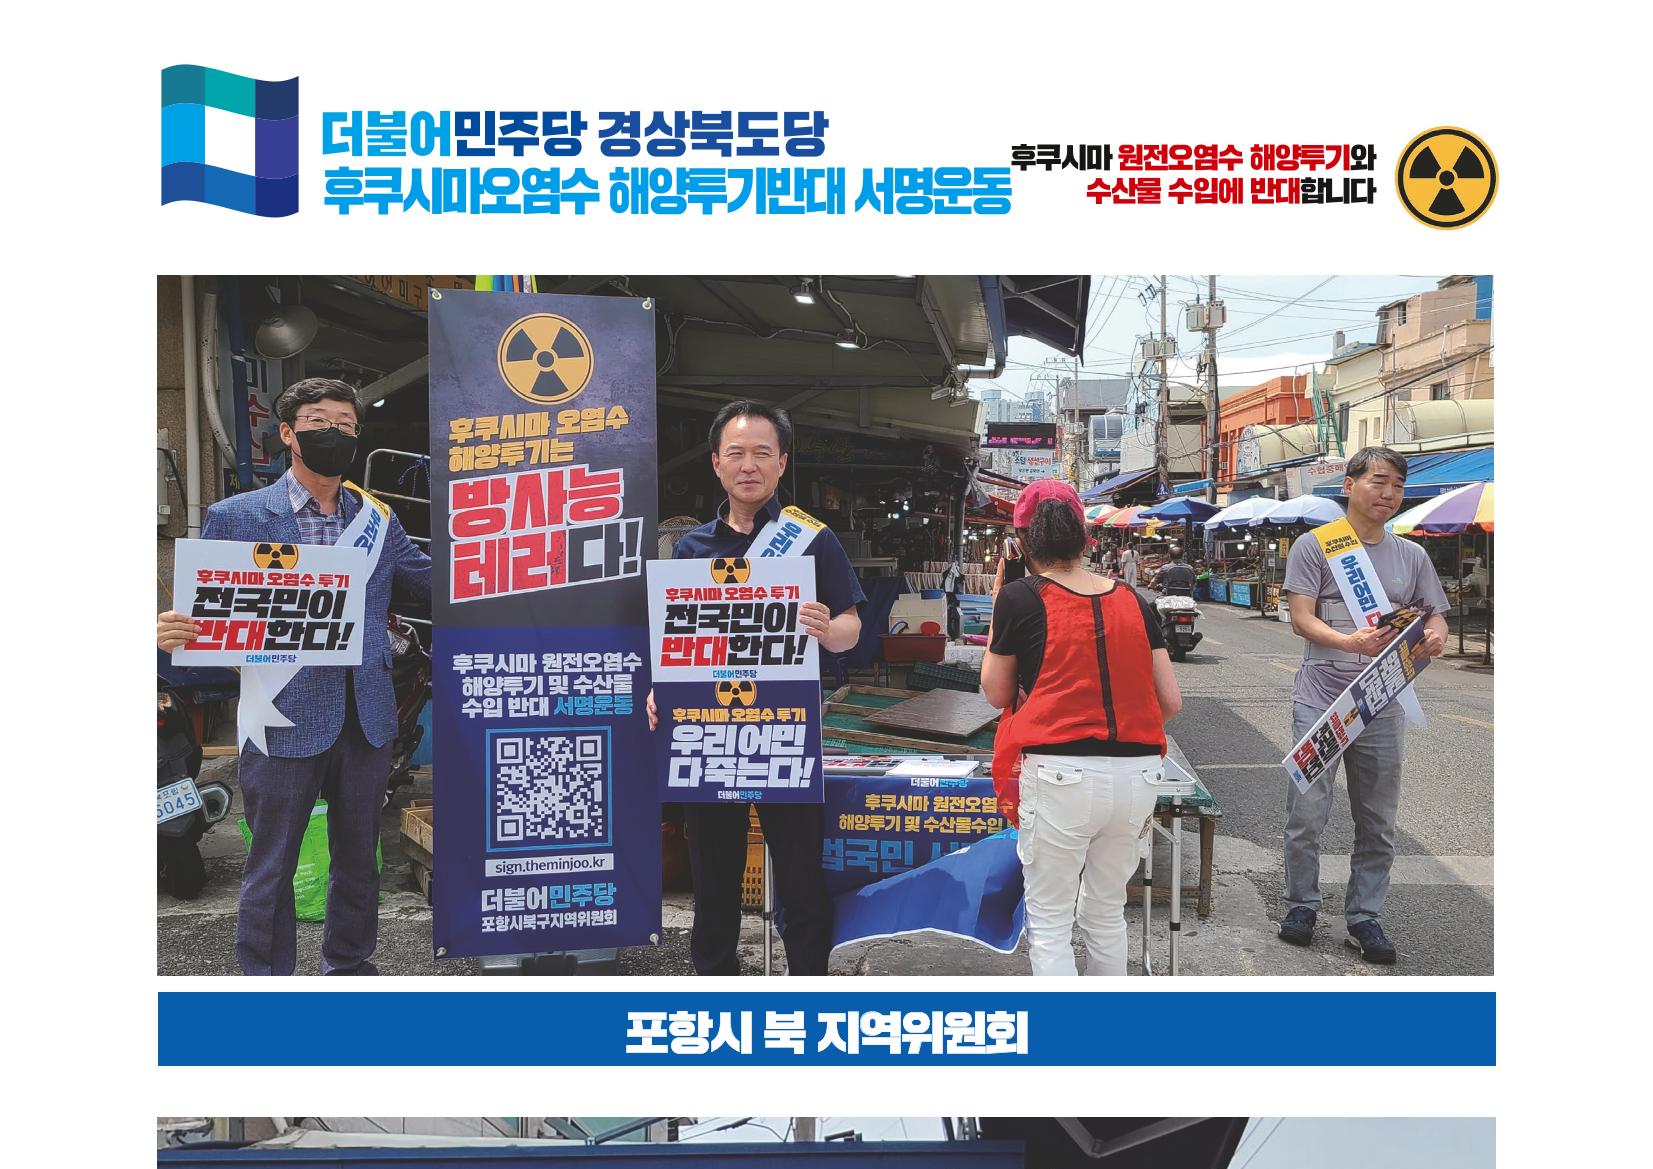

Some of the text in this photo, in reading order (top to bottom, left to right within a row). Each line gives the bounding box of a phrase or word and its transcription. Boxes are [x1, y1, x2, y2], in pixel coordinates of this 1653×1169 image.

[449, 405, 629, 444] 후쿠시마 오염수
[449, 438, 575, 472] 해양투기는
[449, 464, 624, 541] 방사능
[450, 517, 643, 604] 테러다!
[196, 569, 350, 588] 후쿠시마 오염수 투기
[191, 586, 347, 620] 전국민이
[665, 585, 800, 602] 후쿠시마 오염수 투기
[663, 602, 799, 634] 전국민이
[184, 619, 355, 651] 반대한다!
[660, 634, 808, 667] 반대한다!
[452, 652, 642, 674] 후쿠시마 원전오염수
[712, 669, 758, 679] 더불어민주당
[462, 674, 633, 697] 해양투기 및 수산물
[461, 695, 633, 718] 수입 반대 서명운동
[672, 708, 806, 723] 후쿠시마 오염수 투기
[865, 794, 929, 812] 후쿠시마
[838, 814, 900, 832] 해양투기
[904, 815, 920, 832] 및
[495, 856, 605, 875] sign.theminjoo.kr
[481, 882, 616, 912] 더불어민주당
[481, 909, 617, 933] 포항시북구지역위원회
